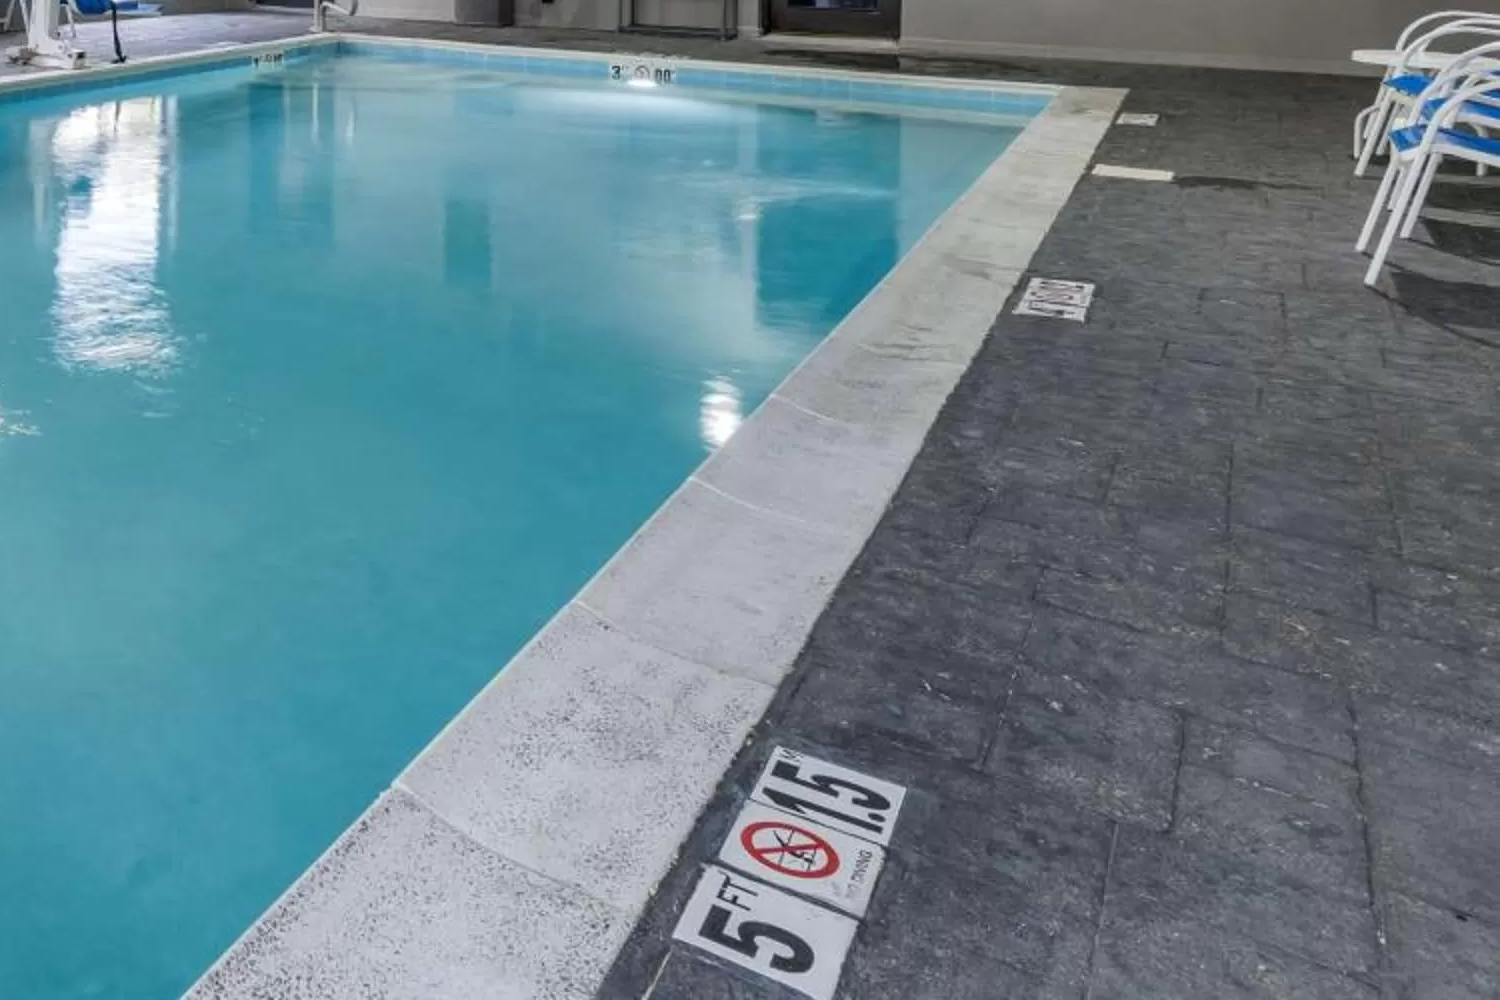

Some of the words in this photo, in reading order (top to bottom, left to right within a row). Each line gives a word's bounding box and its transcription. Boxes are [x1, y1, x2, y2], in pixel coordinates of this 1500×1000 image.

[761, 759, 891, 835] 1.5
[715, 871, 758, 912] FT
[698, 904, 816, 974] 5
